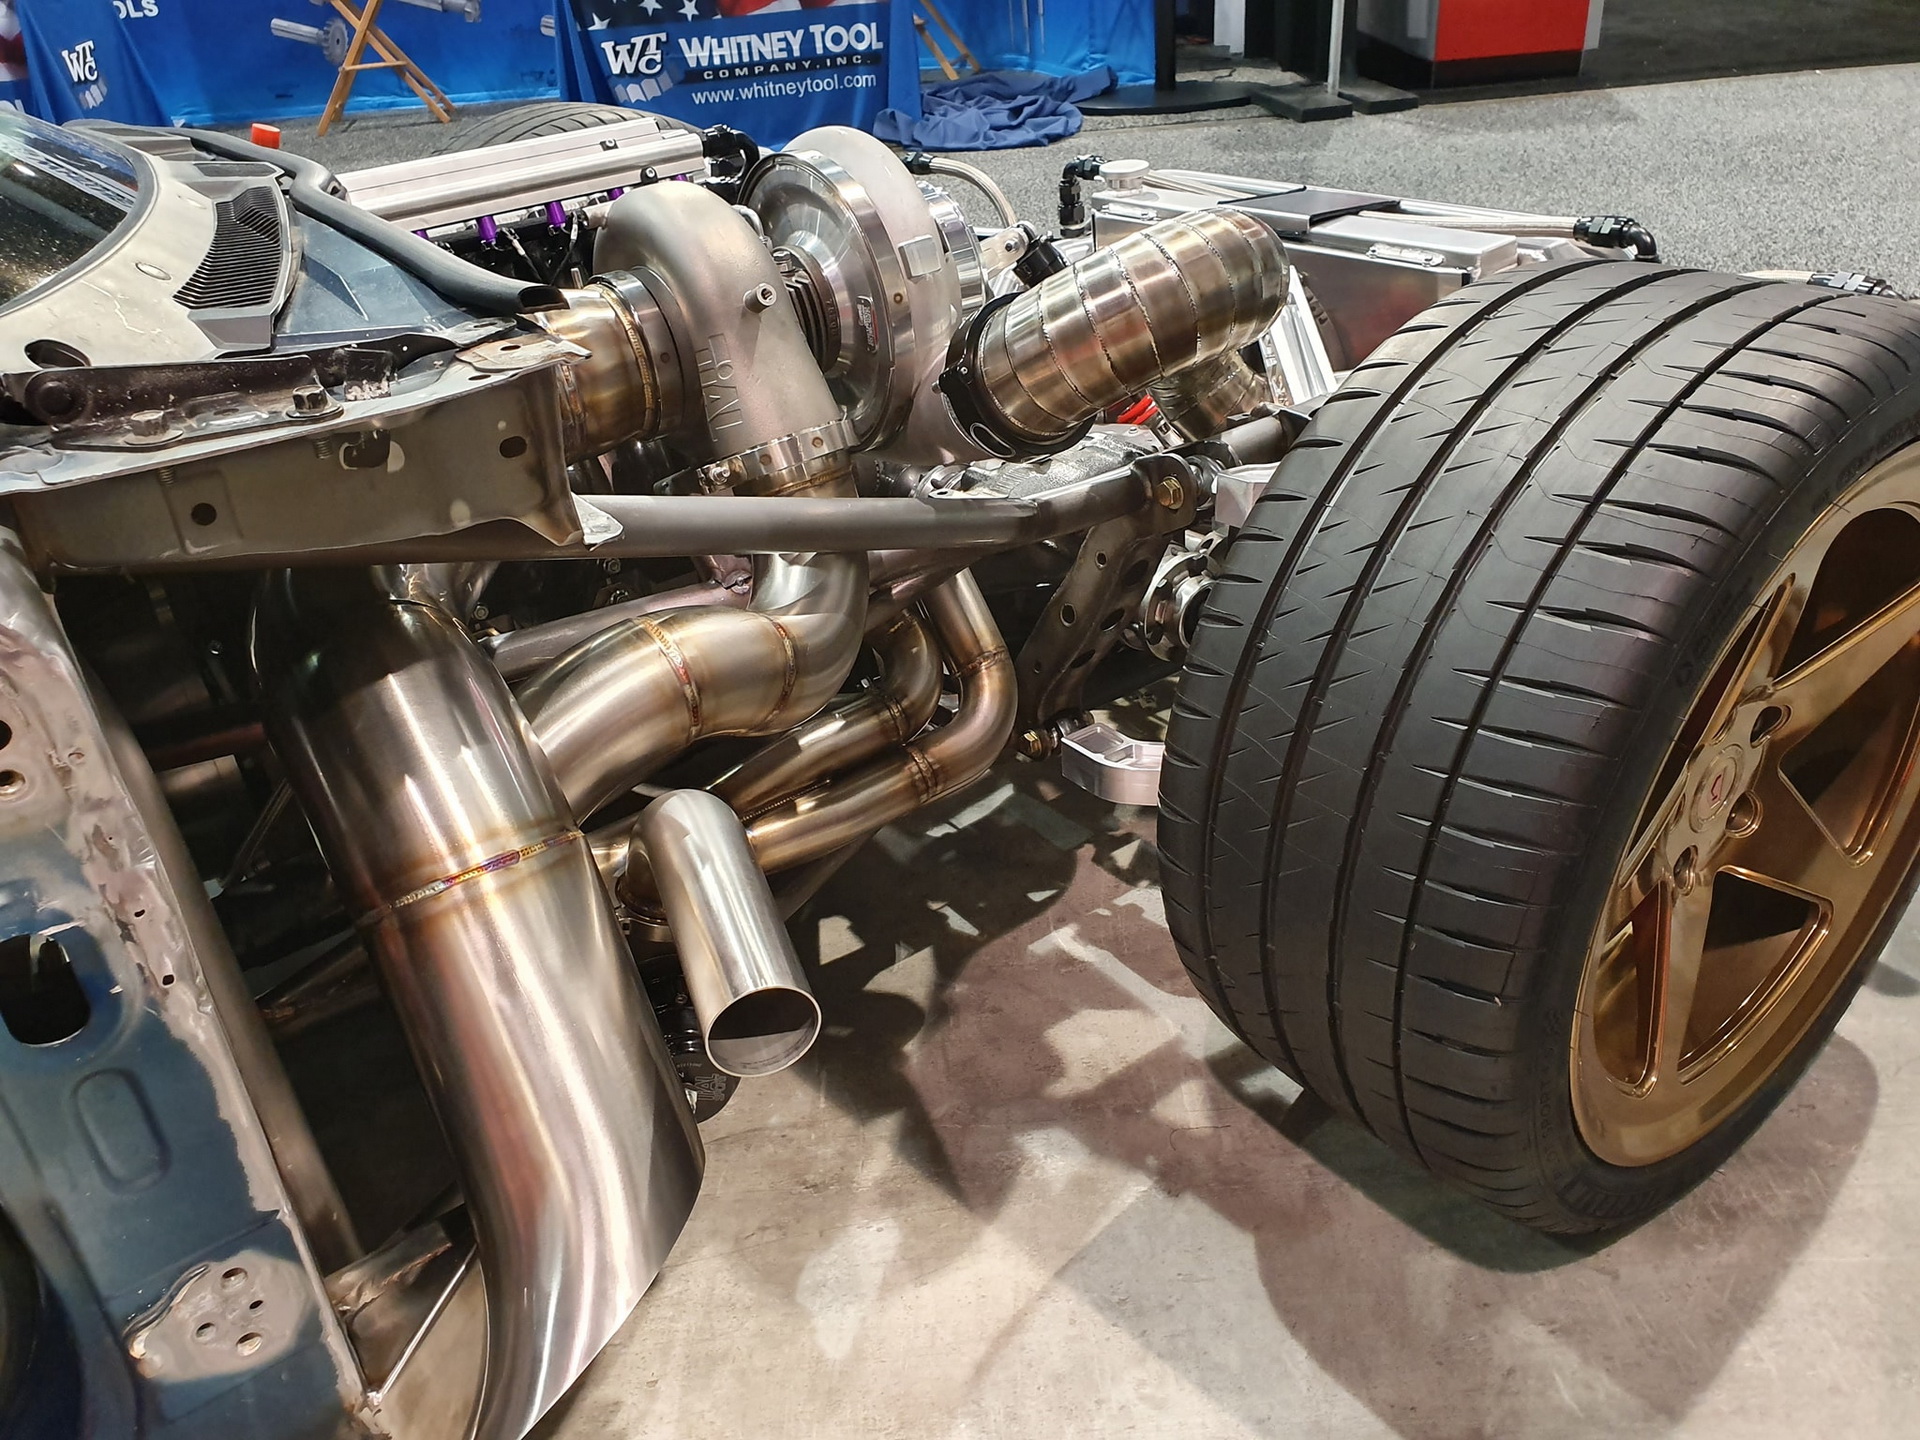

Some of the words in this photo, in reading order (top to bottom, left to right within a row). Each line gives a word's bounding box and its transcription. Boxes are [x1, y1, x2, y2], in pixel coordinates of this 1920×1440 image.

[678, 29, 804, 68] WHITNEY
[809, 22, 883, 54] TOOL
[691, 74, 877, 105] www.whitneytool.com
